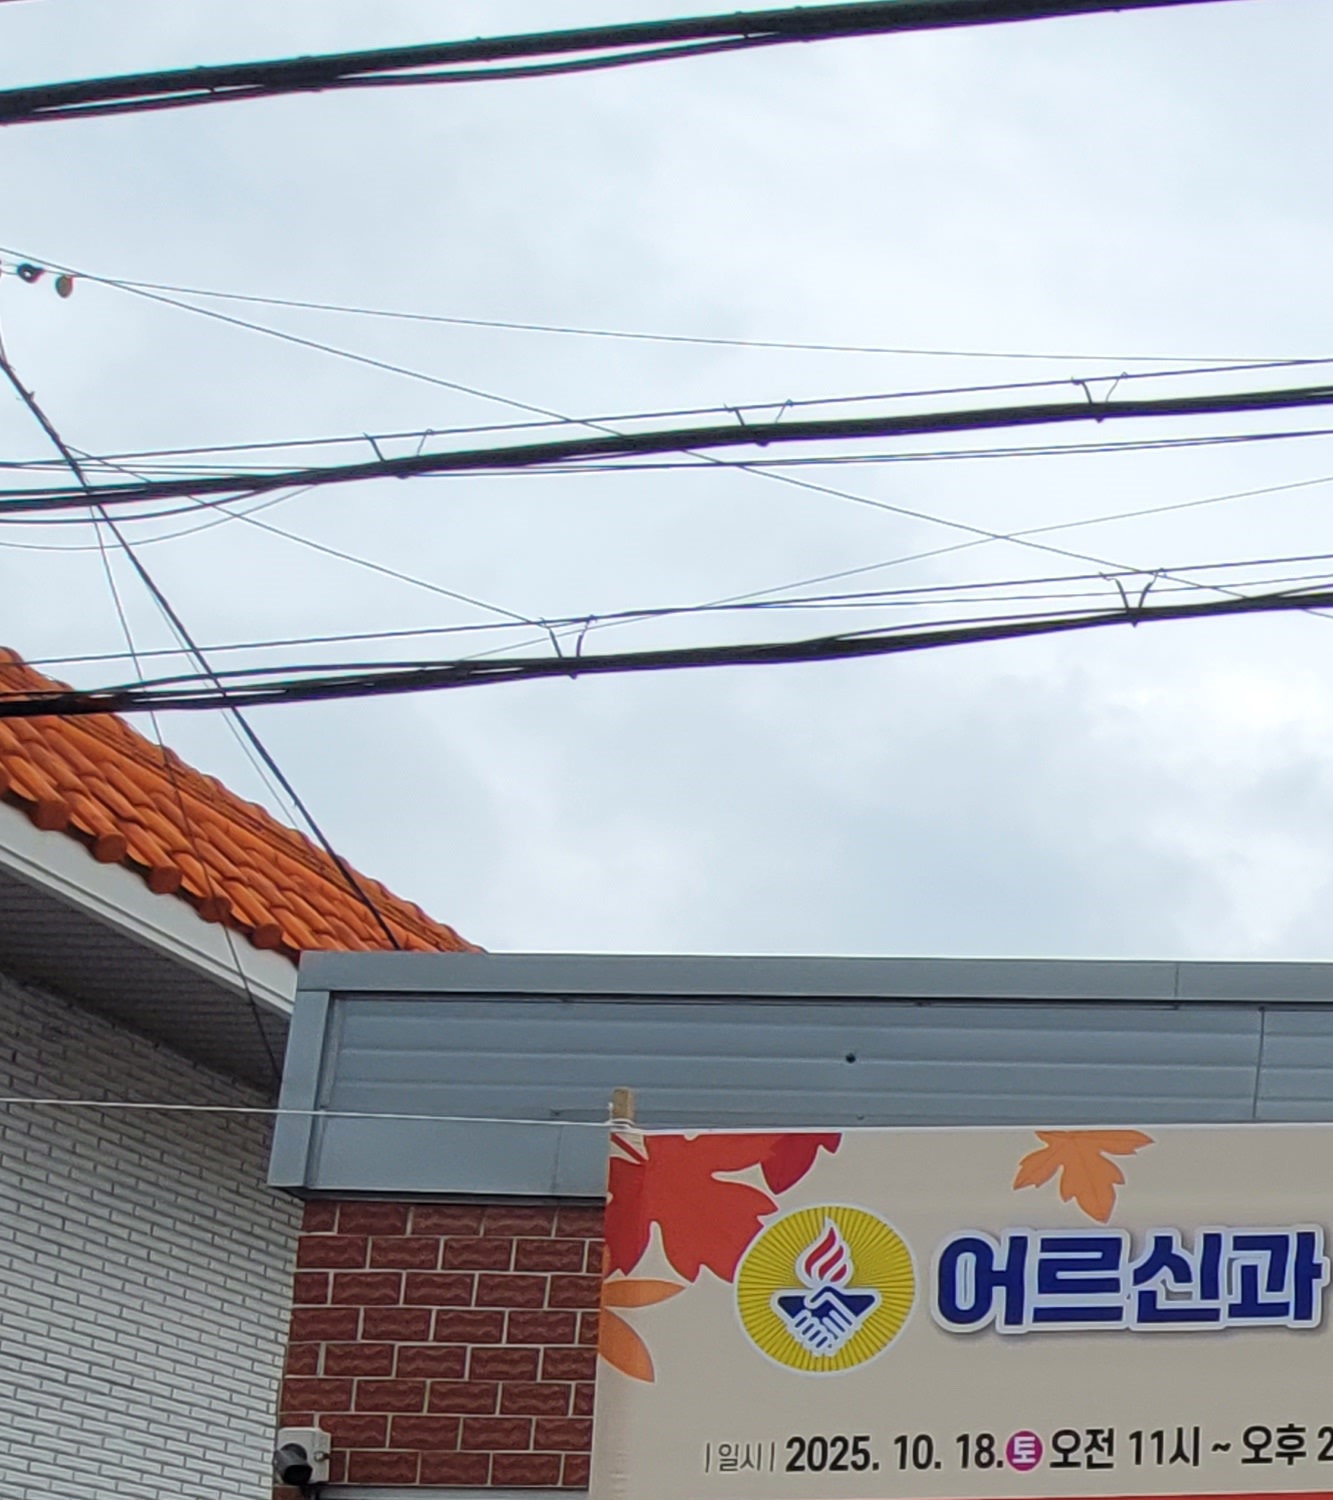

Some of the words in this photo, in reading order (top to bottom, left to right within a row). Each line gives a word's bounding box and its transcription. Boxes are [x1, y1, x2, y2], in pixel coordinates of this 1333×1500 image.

[935, 1228, 1324, 1327] 어르신과
[785, 1436, 880, 1473] 2025.
[893, 1435, 942, 1472] 10.
[955, 1433, 1004, 1470] 18.
[1049, 1428, 1115, 1470] 오전
